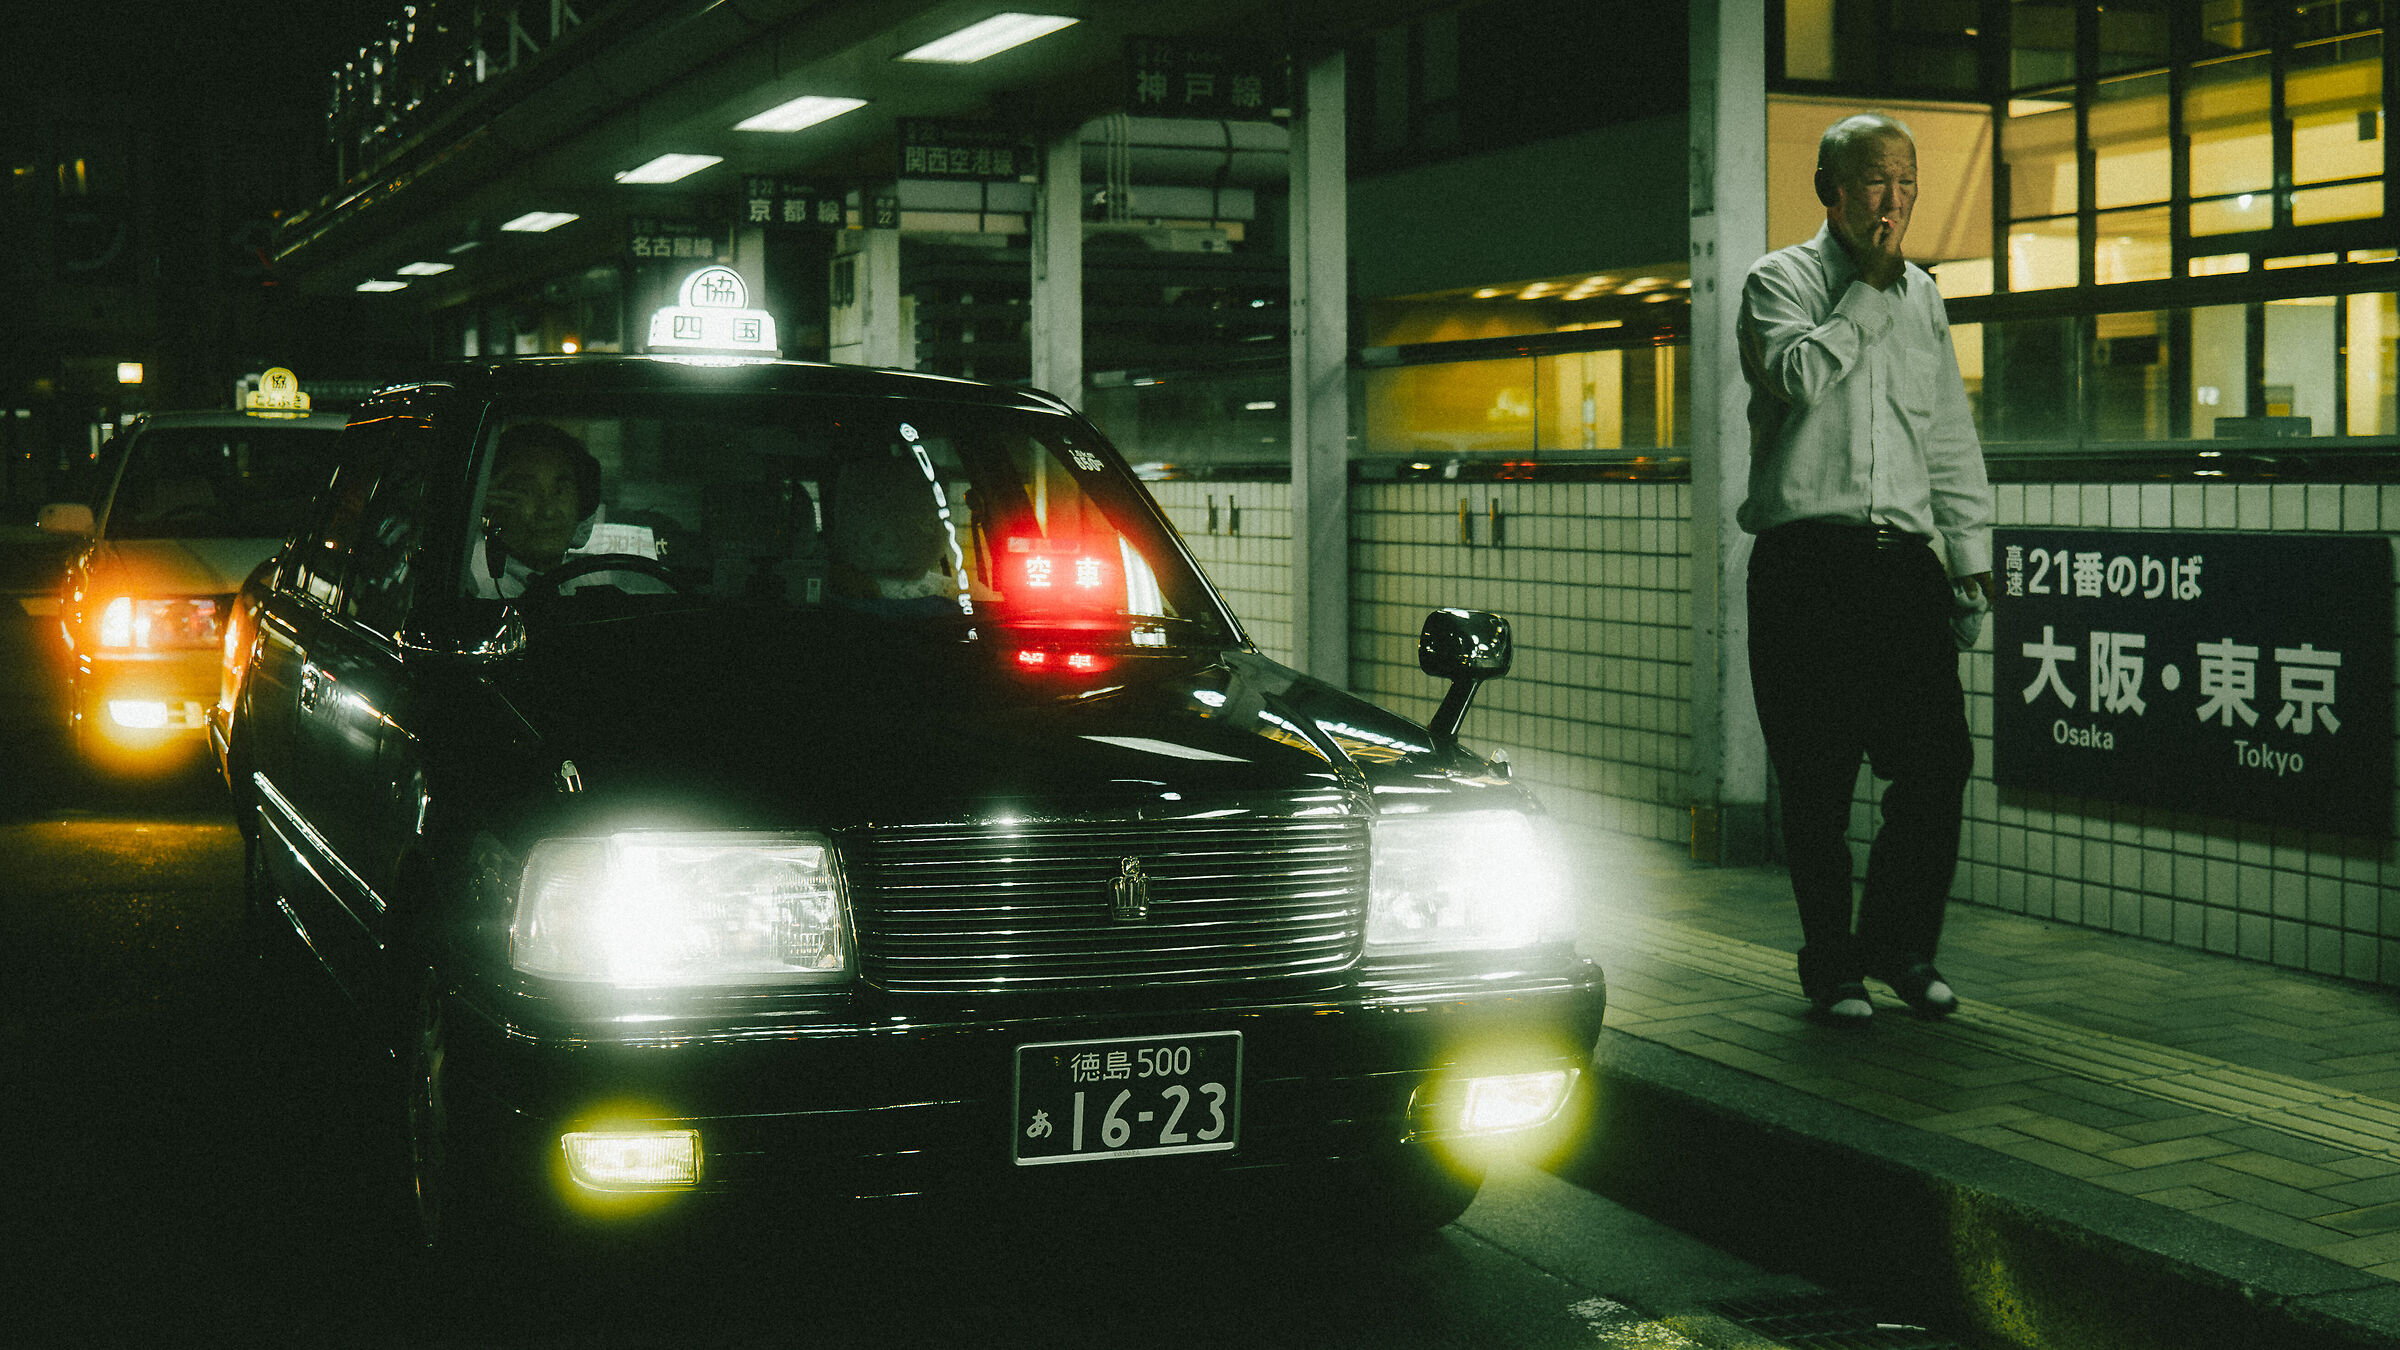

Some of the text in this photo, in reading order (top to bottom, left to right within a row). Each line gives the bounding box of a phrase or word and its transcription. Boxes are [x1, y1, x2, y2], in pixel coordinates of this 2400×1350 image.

[1136, 70, 1263, 107] 神戸線
[905, 146, 1013, 176] 関西空港線
[749, 199, 840, 224] 京都線
[701, 275, 736, 303] 協
[674, 314, 761, 343] 四国
[1026, 554, 1103, 590] 空車
[2005, 545, 2023, 597] 高速
[2028, 548, 2204, 601] 21番のりば
[2022, 625, 2342, 735] 大阪・東京
[2053, 720, 2304, 776] Osaka Tokyo
[1070, 1046, 1191, 1083] 徳島 500
[1026, 1082, 1227, 1151] あ 16-23
